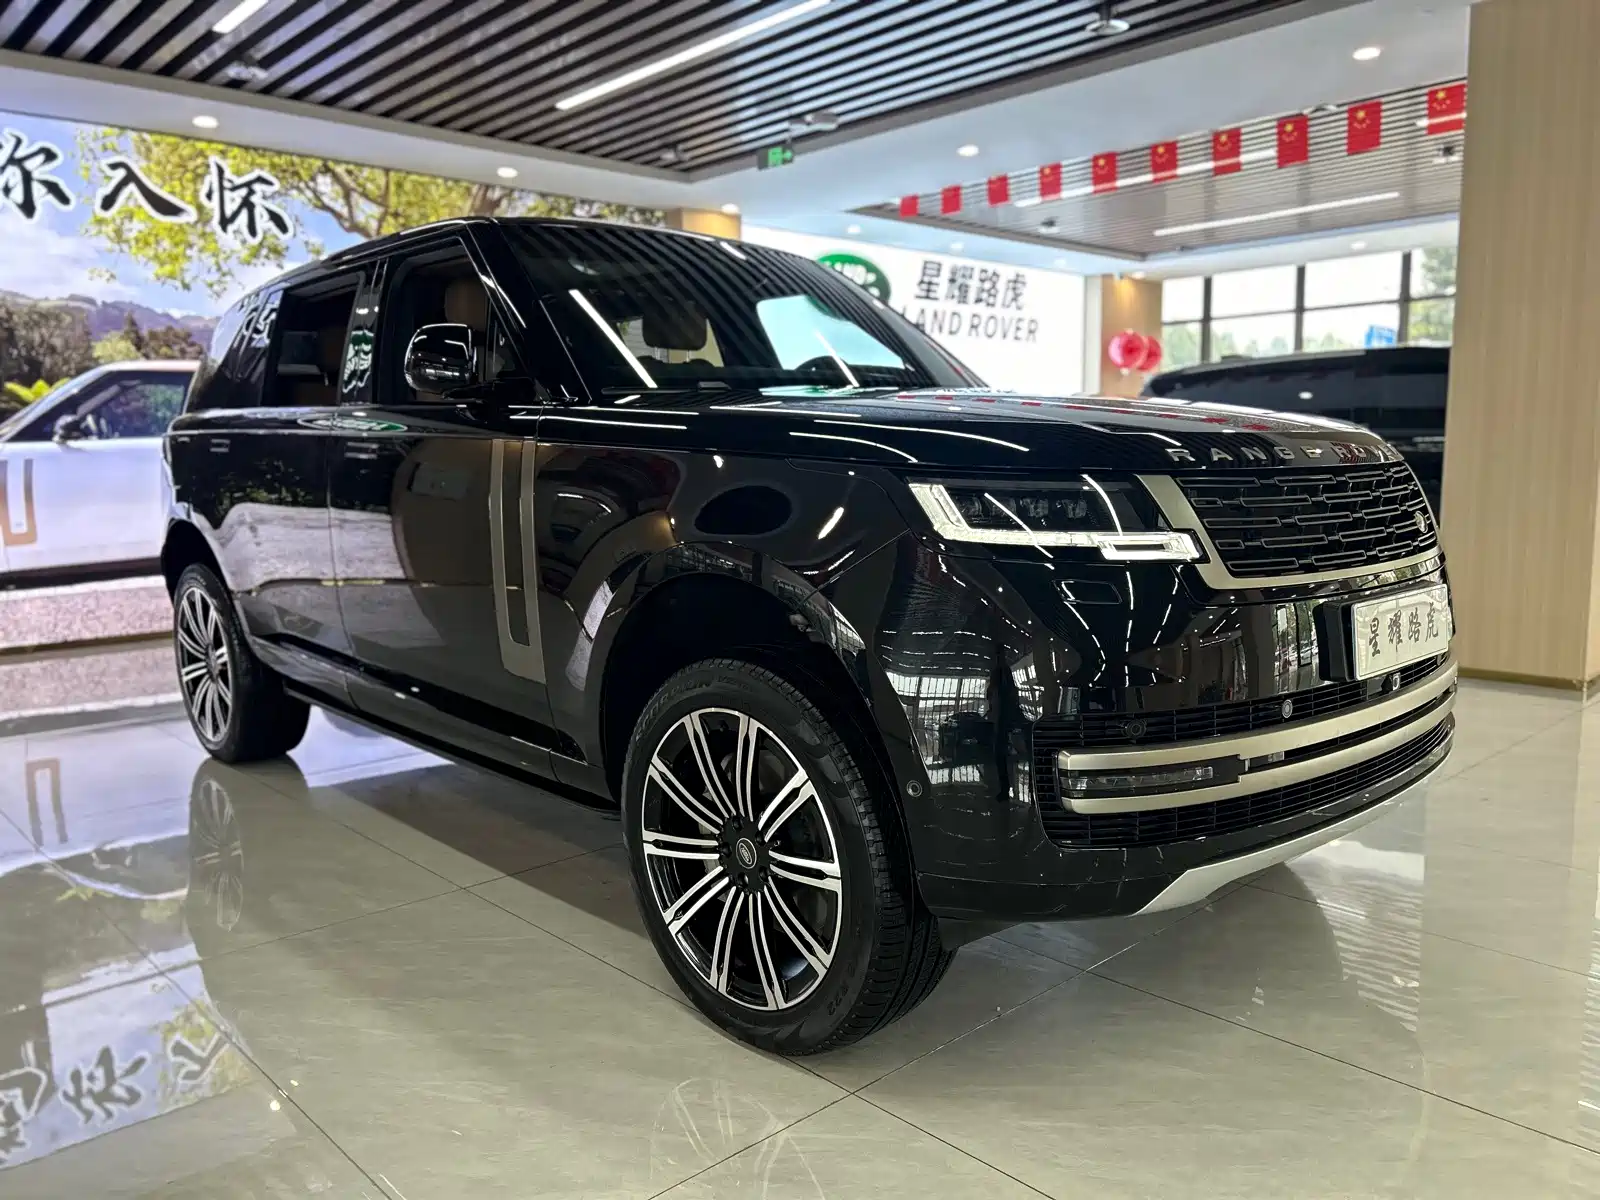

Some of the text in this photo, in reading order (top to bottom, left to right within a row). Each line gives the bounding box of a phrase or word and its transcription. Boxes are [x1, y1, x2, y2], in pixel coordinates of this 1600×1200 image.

[914, 259, 1028, 311] 星耀路虎
[967, 310, 1040, 343] ROVER
[1165, 445, 1323, 463] RANGE
[1368, 601, 1439, 658] 星耀路虎
